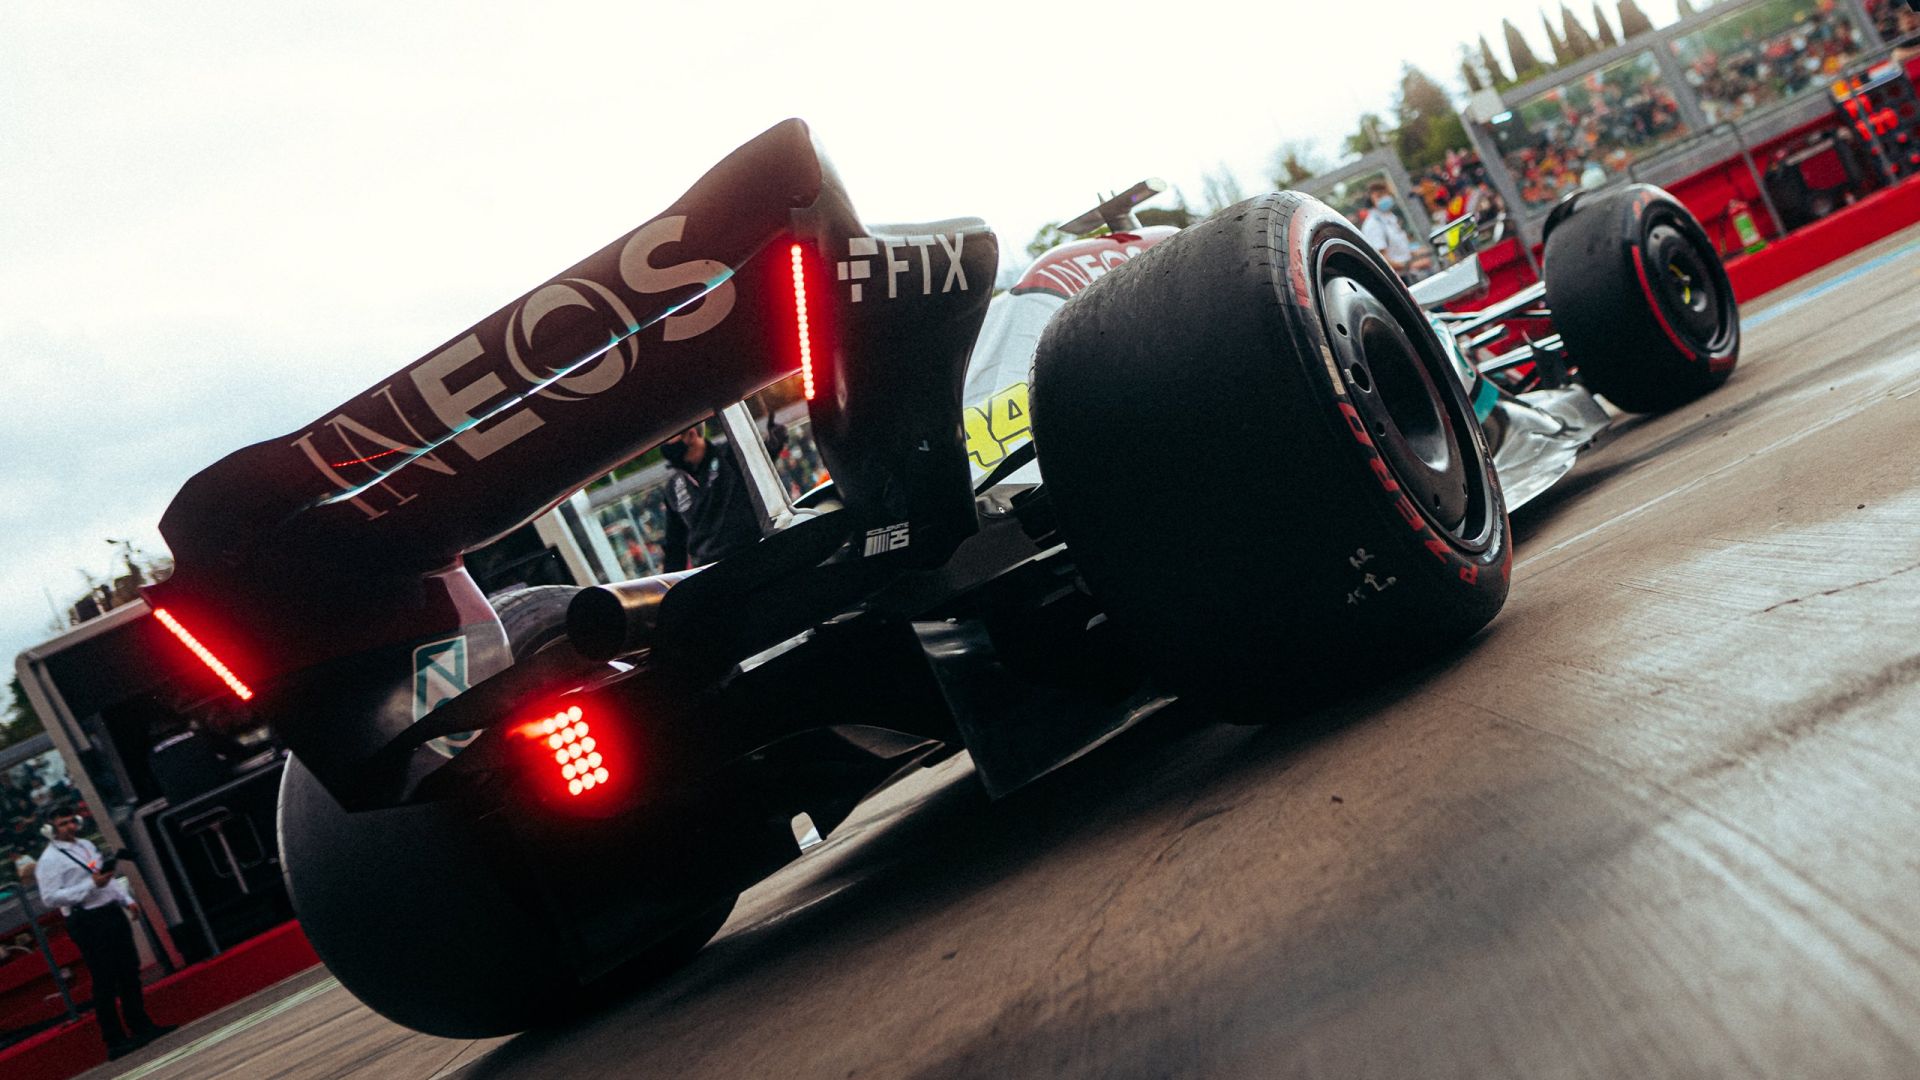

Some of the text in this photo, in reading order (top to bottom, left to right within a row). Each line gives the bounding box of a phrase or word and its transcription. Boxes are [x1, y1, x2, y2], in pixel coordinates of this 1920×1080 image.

[883, 233, 968, 299] FTX
[1036, 246, 1142, 297] INEO
[291, 215, 736, 521] INEOS
